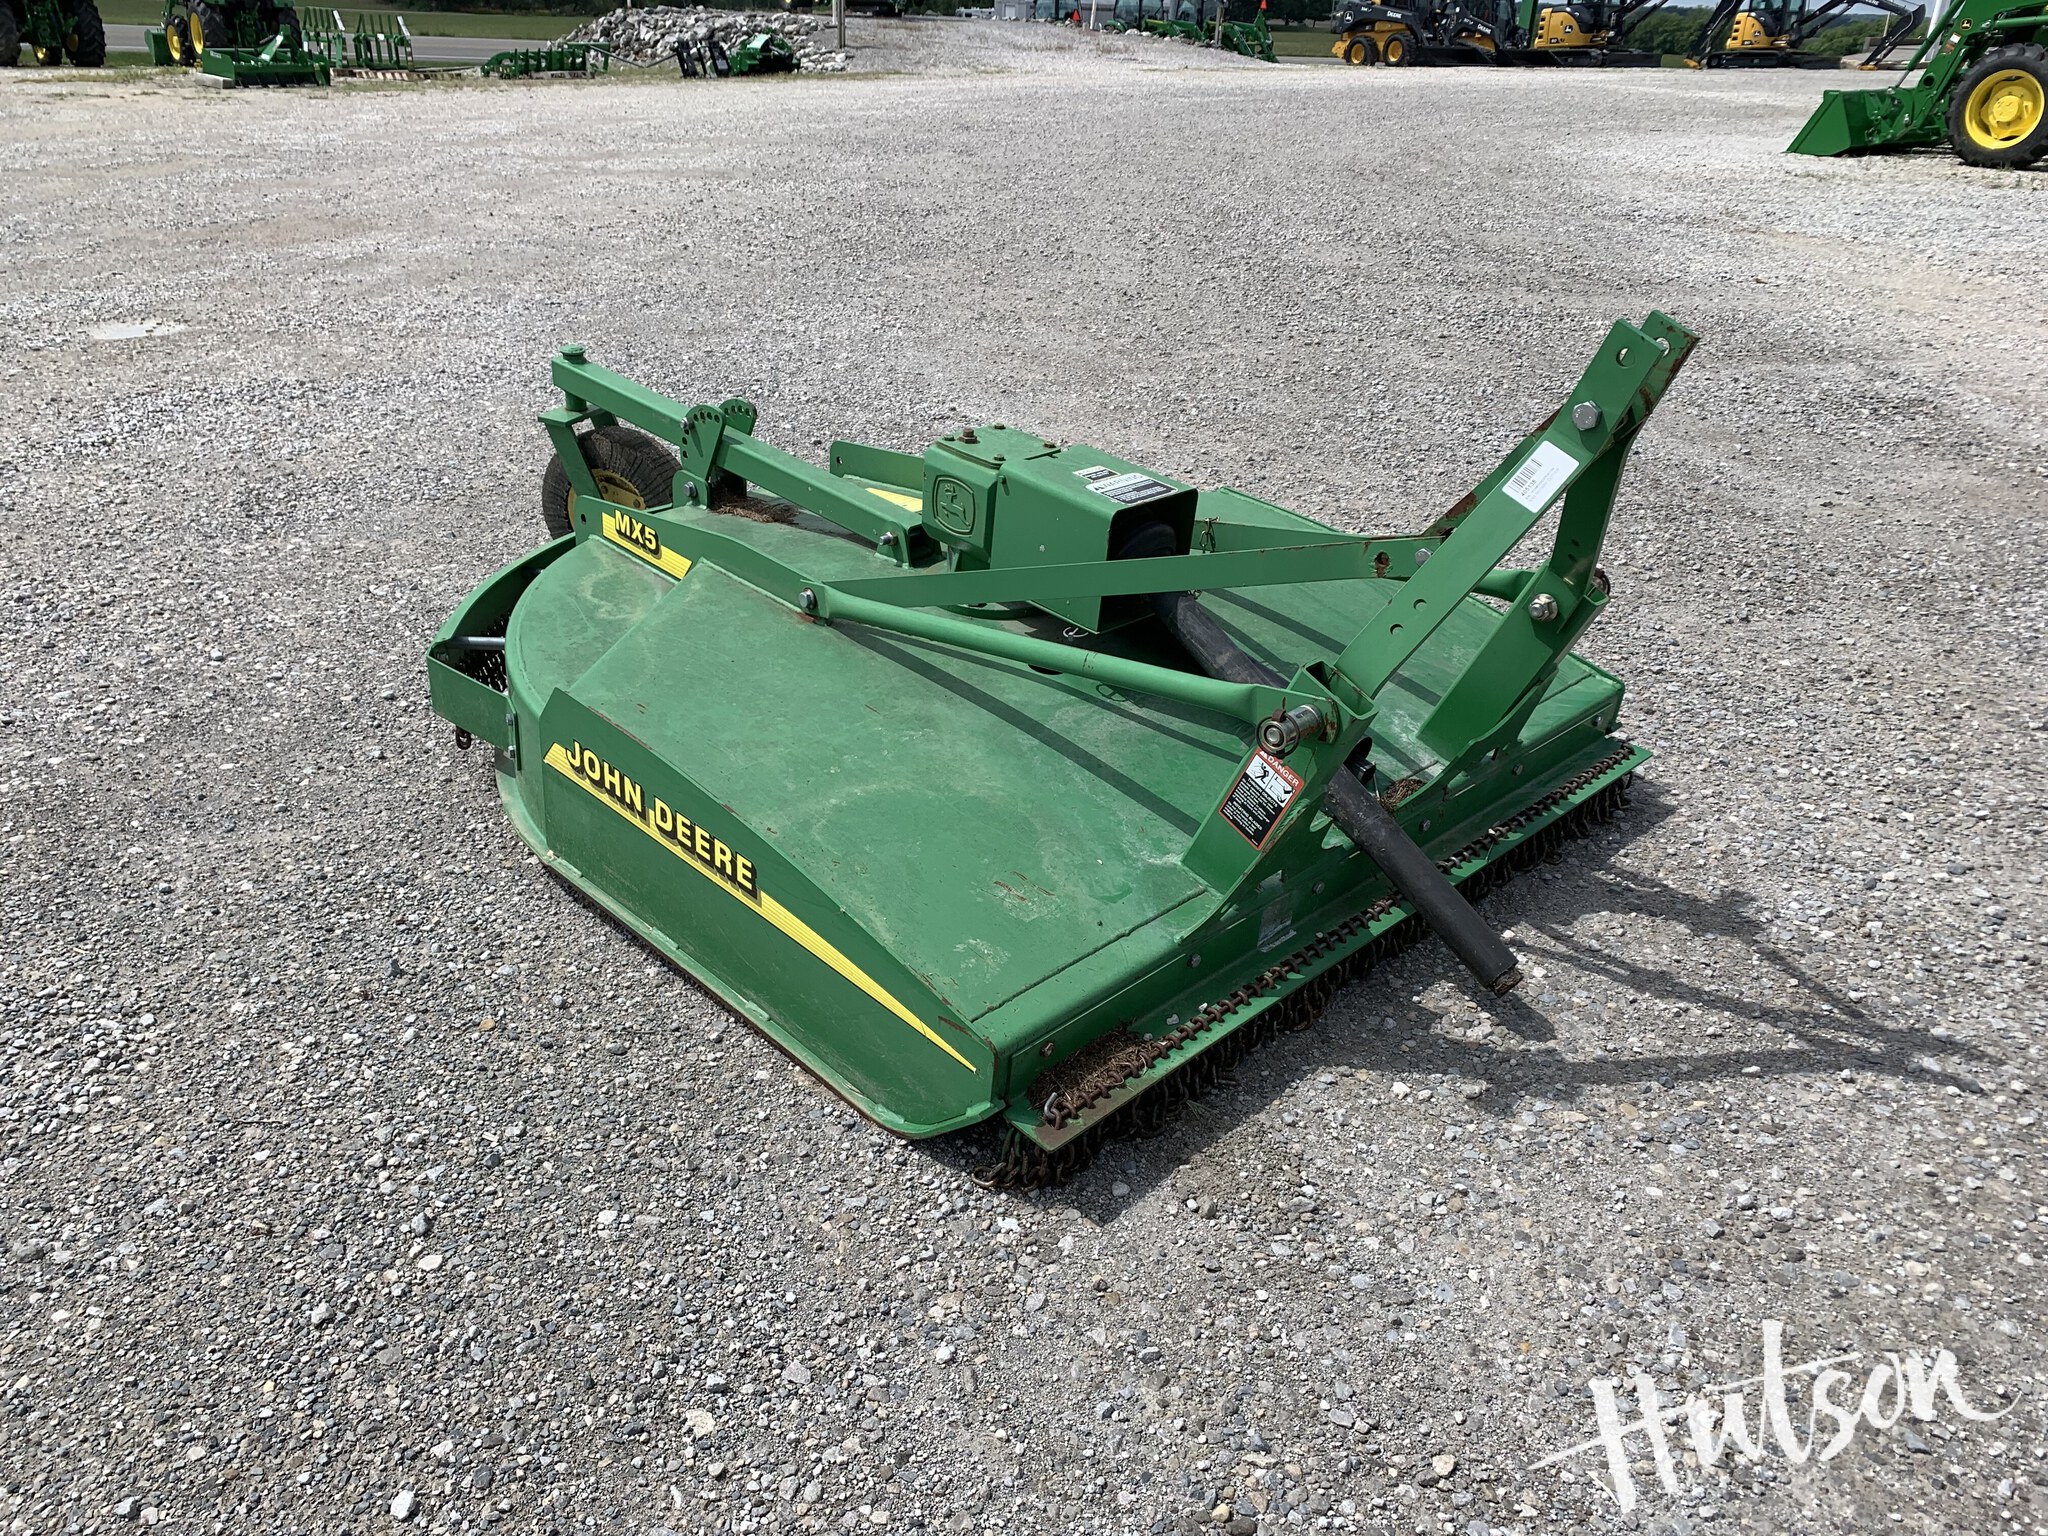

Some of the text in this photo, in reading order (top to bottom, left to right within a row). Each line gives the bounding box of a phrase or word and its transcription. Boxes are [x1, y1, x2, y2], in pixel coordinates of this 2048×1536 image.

[615, 509, 660, 556] MX5
[1267, 756, 1299, 787] DANGER
[565, 739, 757, 894] JOHN DEERE
